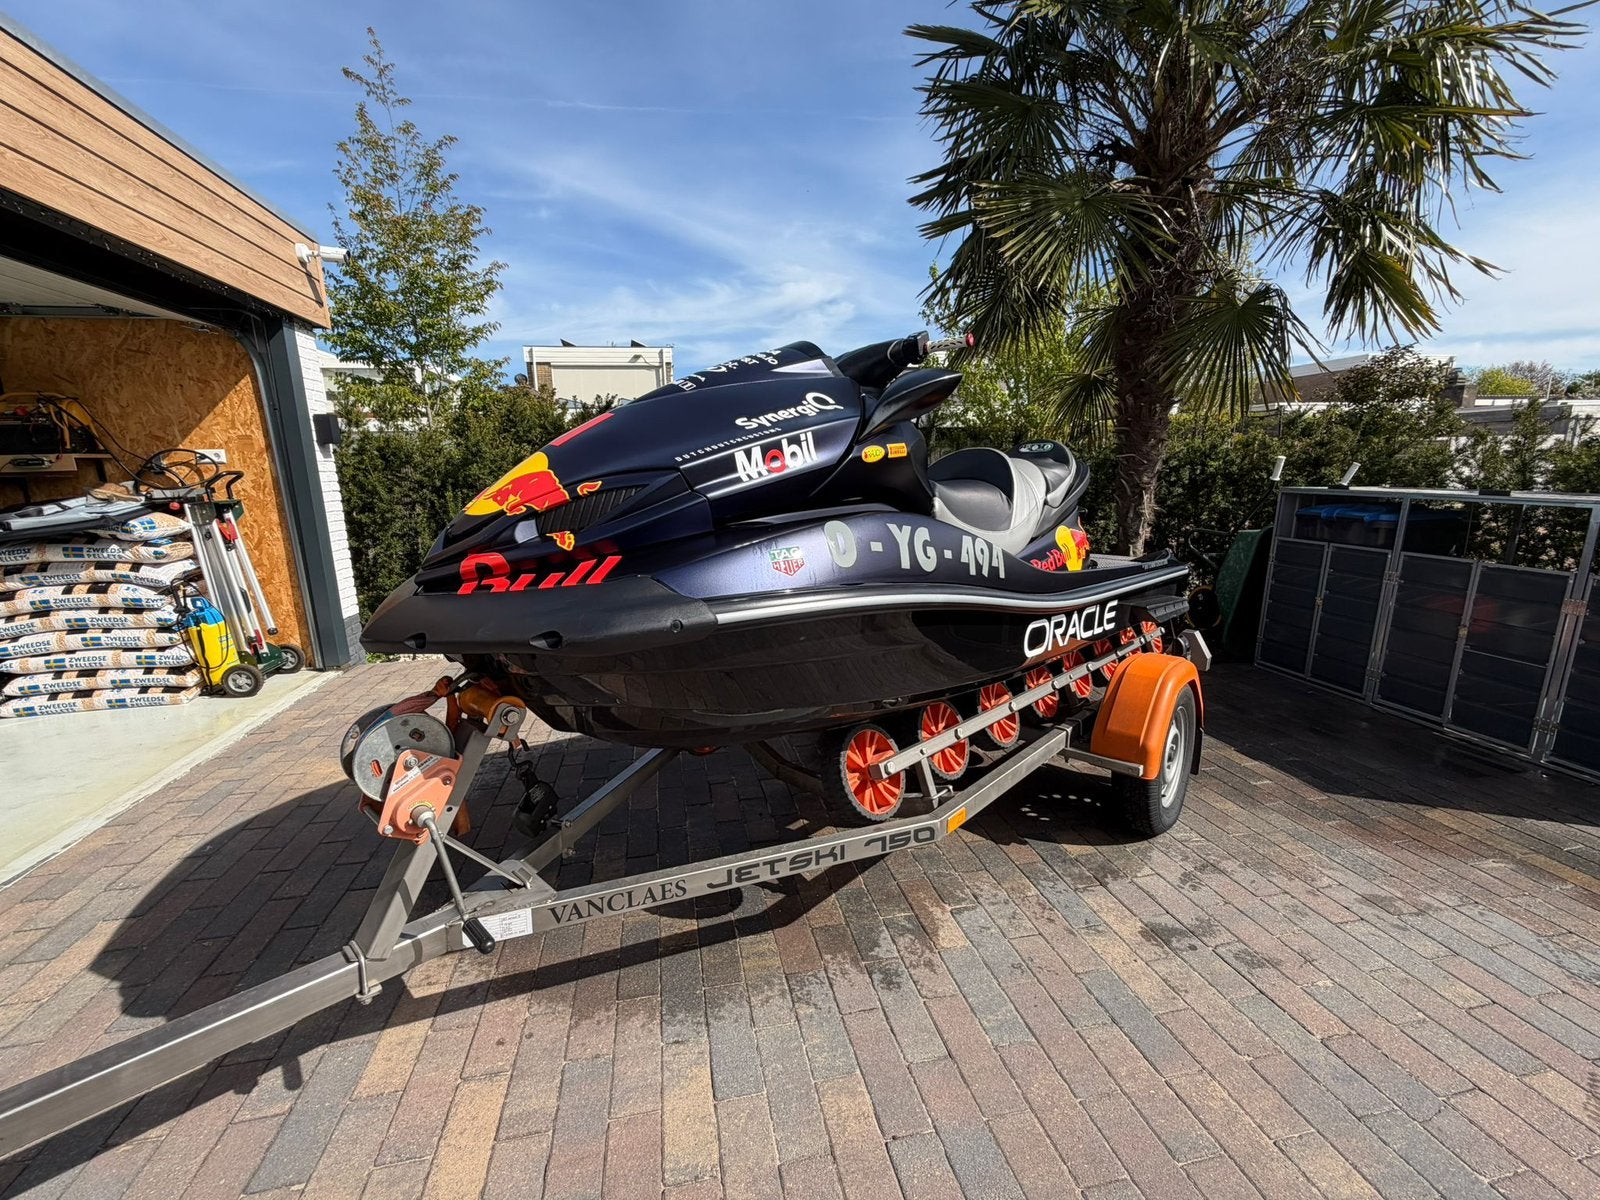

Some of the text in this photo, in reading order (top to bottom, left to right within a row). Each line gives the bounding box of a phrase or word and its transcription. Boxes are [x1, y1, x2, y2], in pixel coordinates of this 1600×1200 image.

[735, 391, 844, 430] SynergiQ
[733, 431, 819, 483] Mobil
[770, 547, 801, 560] TAG
[886, 523, 938, 572] YG
[773, 559, 804, 575] HEUER
[1023, 599, 1119, 658] ORACLE
[12, 640, 52, 651] ZWEEDSE
[68, 655, 107, 663] ZWEEDSE
[42, 681, 82, 689] ZWEEDSE
[547, 879, 688, 925] VANCLAES
[706, 844, 846, 890] JETSKI
[863, 826, 936, 853] 750
